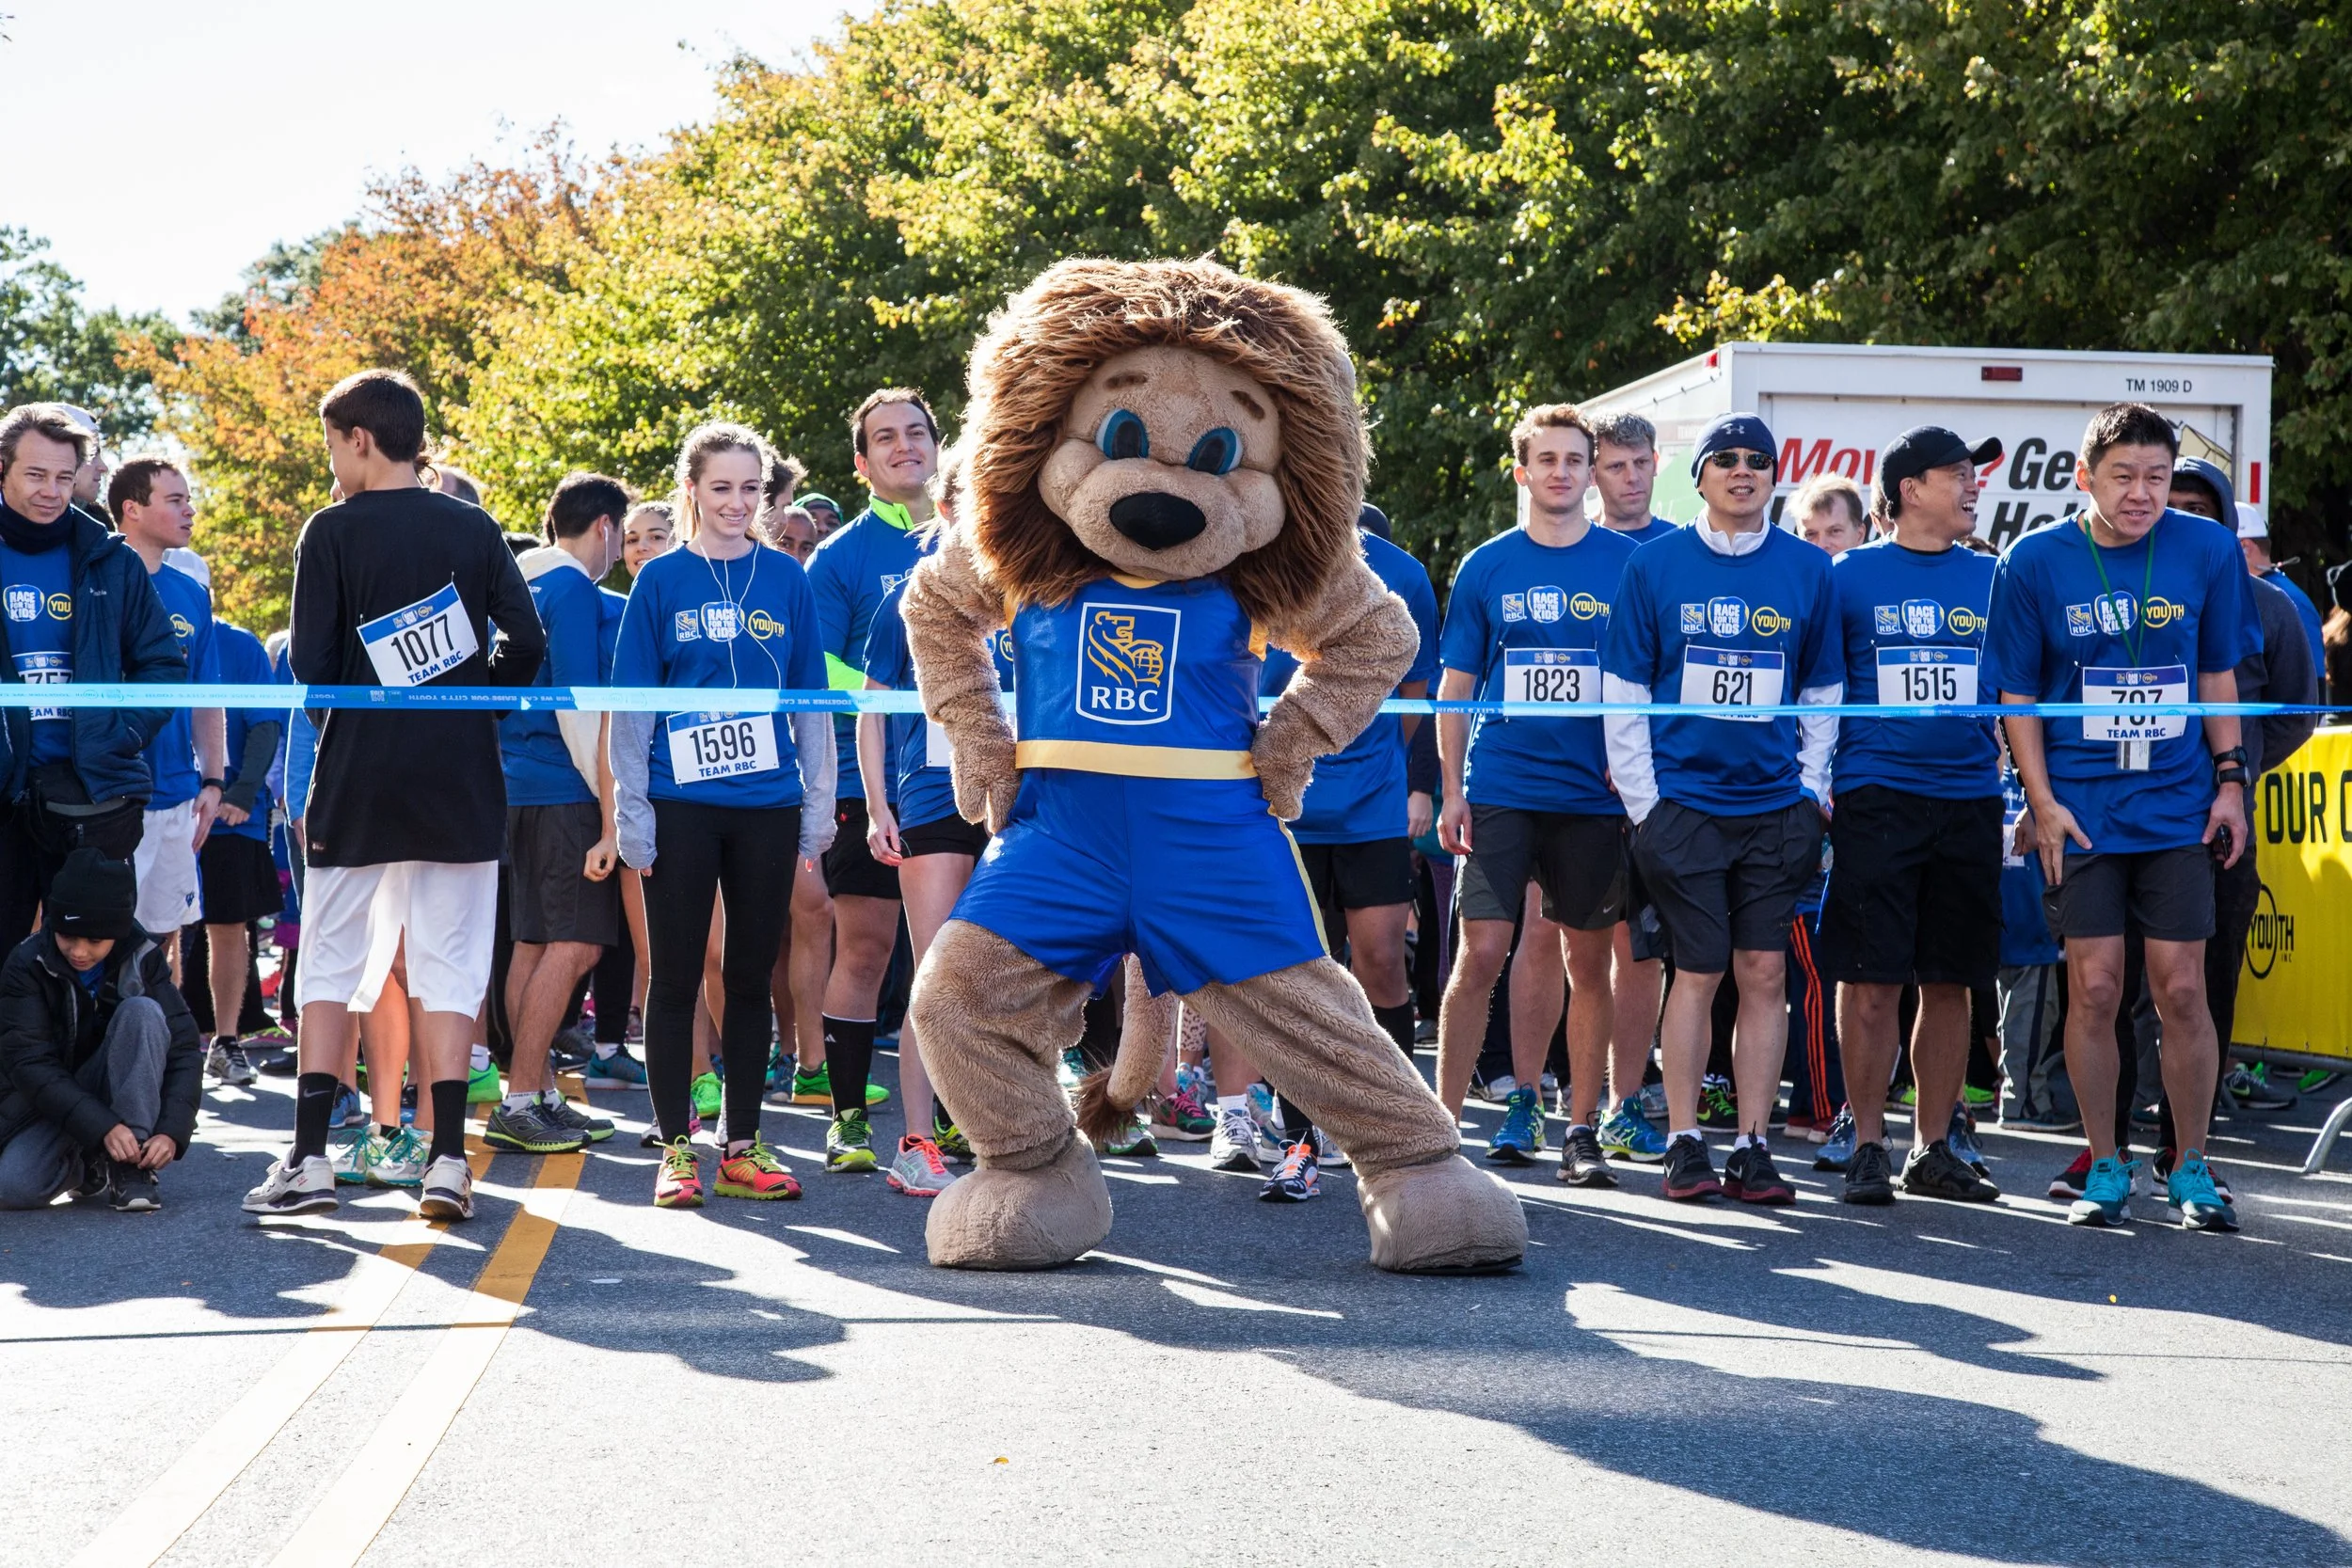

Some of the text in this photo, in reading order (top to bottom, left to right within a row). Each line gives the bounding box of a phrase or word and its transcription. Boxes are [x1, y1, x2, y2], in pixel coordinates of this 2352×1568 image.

[2126, 378, 2192, 393] TM 1909 D
[2009, 437, 2082, 491] Ge
[8, 591, 36, 603] RACE
[1533, 592, 1559, 604] RACE
[51, 600, 72, 612] YOU
[1574, 600, 1610, 614] YOUTH
[1713, 603, 1740, 616] RACE
[1907, 605, 1935, 617] RACE
[2146, 604, 2185, 620] YOUTH
[10, 609, 37, 620] KIDS
[707, 609, 736, 621] RACE
[1505, 611, 1522, 621] RBC
[1533, 610, 1560, 622] KIDS
[752, 617, 785, 636] YOUTH
[1713, 623, 1740, 635] KIDS
[1756, 614, 1791, 630] YOUTH
[1879, 625, 1898, 633] RBC
[1952, 614, 1987, 630] YOUTH
[678, 630, 697, 640] RBC
[707, 626, 737, 639] KIDS
[1908, 624, 1936, 635] KIDS
[2072, 625, 2091, 634] RBC
[390, 613, 454, 672] 1077
[407, 650, 464, 684] TEAM RBC
[1522, 668, 1581, 703] 1823
[1711, 669, 1754, 705] 621
[1900, 667, 1957, 702] 1515
[1091, 686, 1159, 713] RBC
[30, 706, 53, 718] EAM
[2110, 689, 2163, 726] 707
[2106, 728, 2167, 739] TEAM RBC
[689, 721, 756, 766] 1596
[698, 760, 757, 778] TEAM RBC
[2265, 771, 2328, 845] OUR
[2251, 913, 2295, 952] YOUTH
